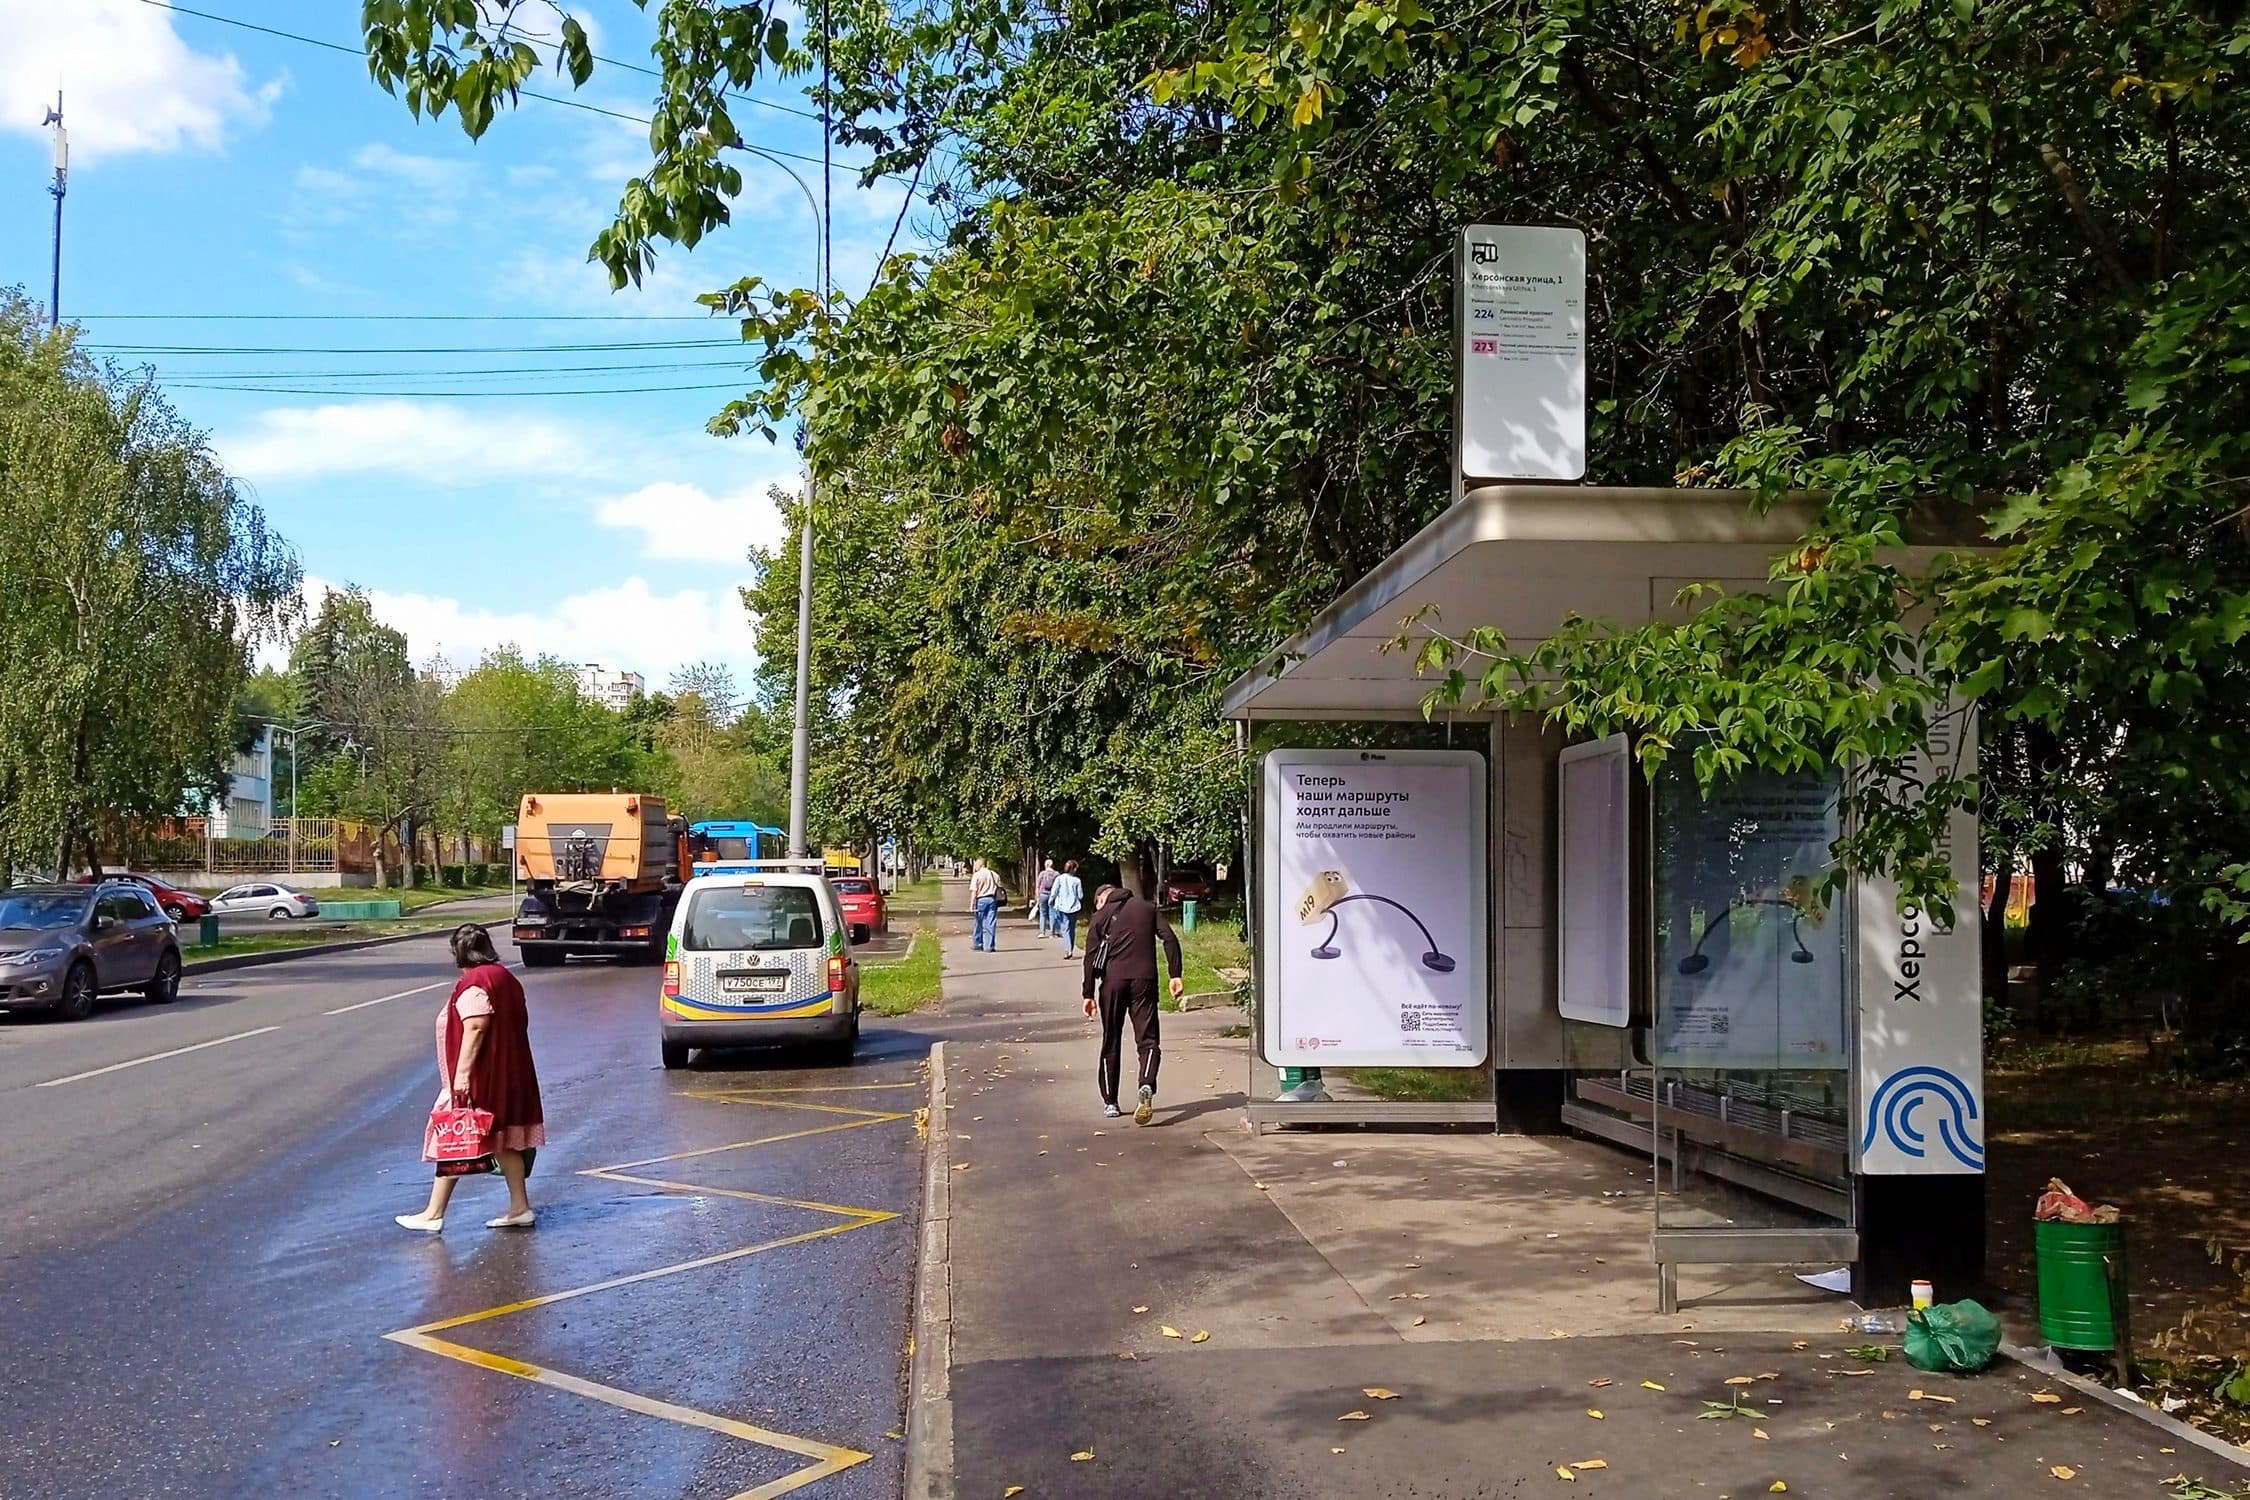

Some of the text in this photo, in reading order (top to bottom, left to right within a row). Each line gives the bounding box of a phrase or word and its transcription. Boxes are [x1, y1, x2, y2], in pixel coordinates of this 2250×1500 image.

[1472, 272, 1563, 285] Херсонская улица, 1
[1474, 309, 1494, 319] 224
[1474, 342, 1494, 352] 273
[1296, 774, 1346, 788] Теперь
[1297, 792, 1409, 804] наши маршруты
[1296, 807, 1391, 817] ходят дальше
[1296, 822, 1398, 831] Мы продлили маршруты,
[1296, 831, 1320, 839] чтобы
[1386, 832, 1416, 840] районы
